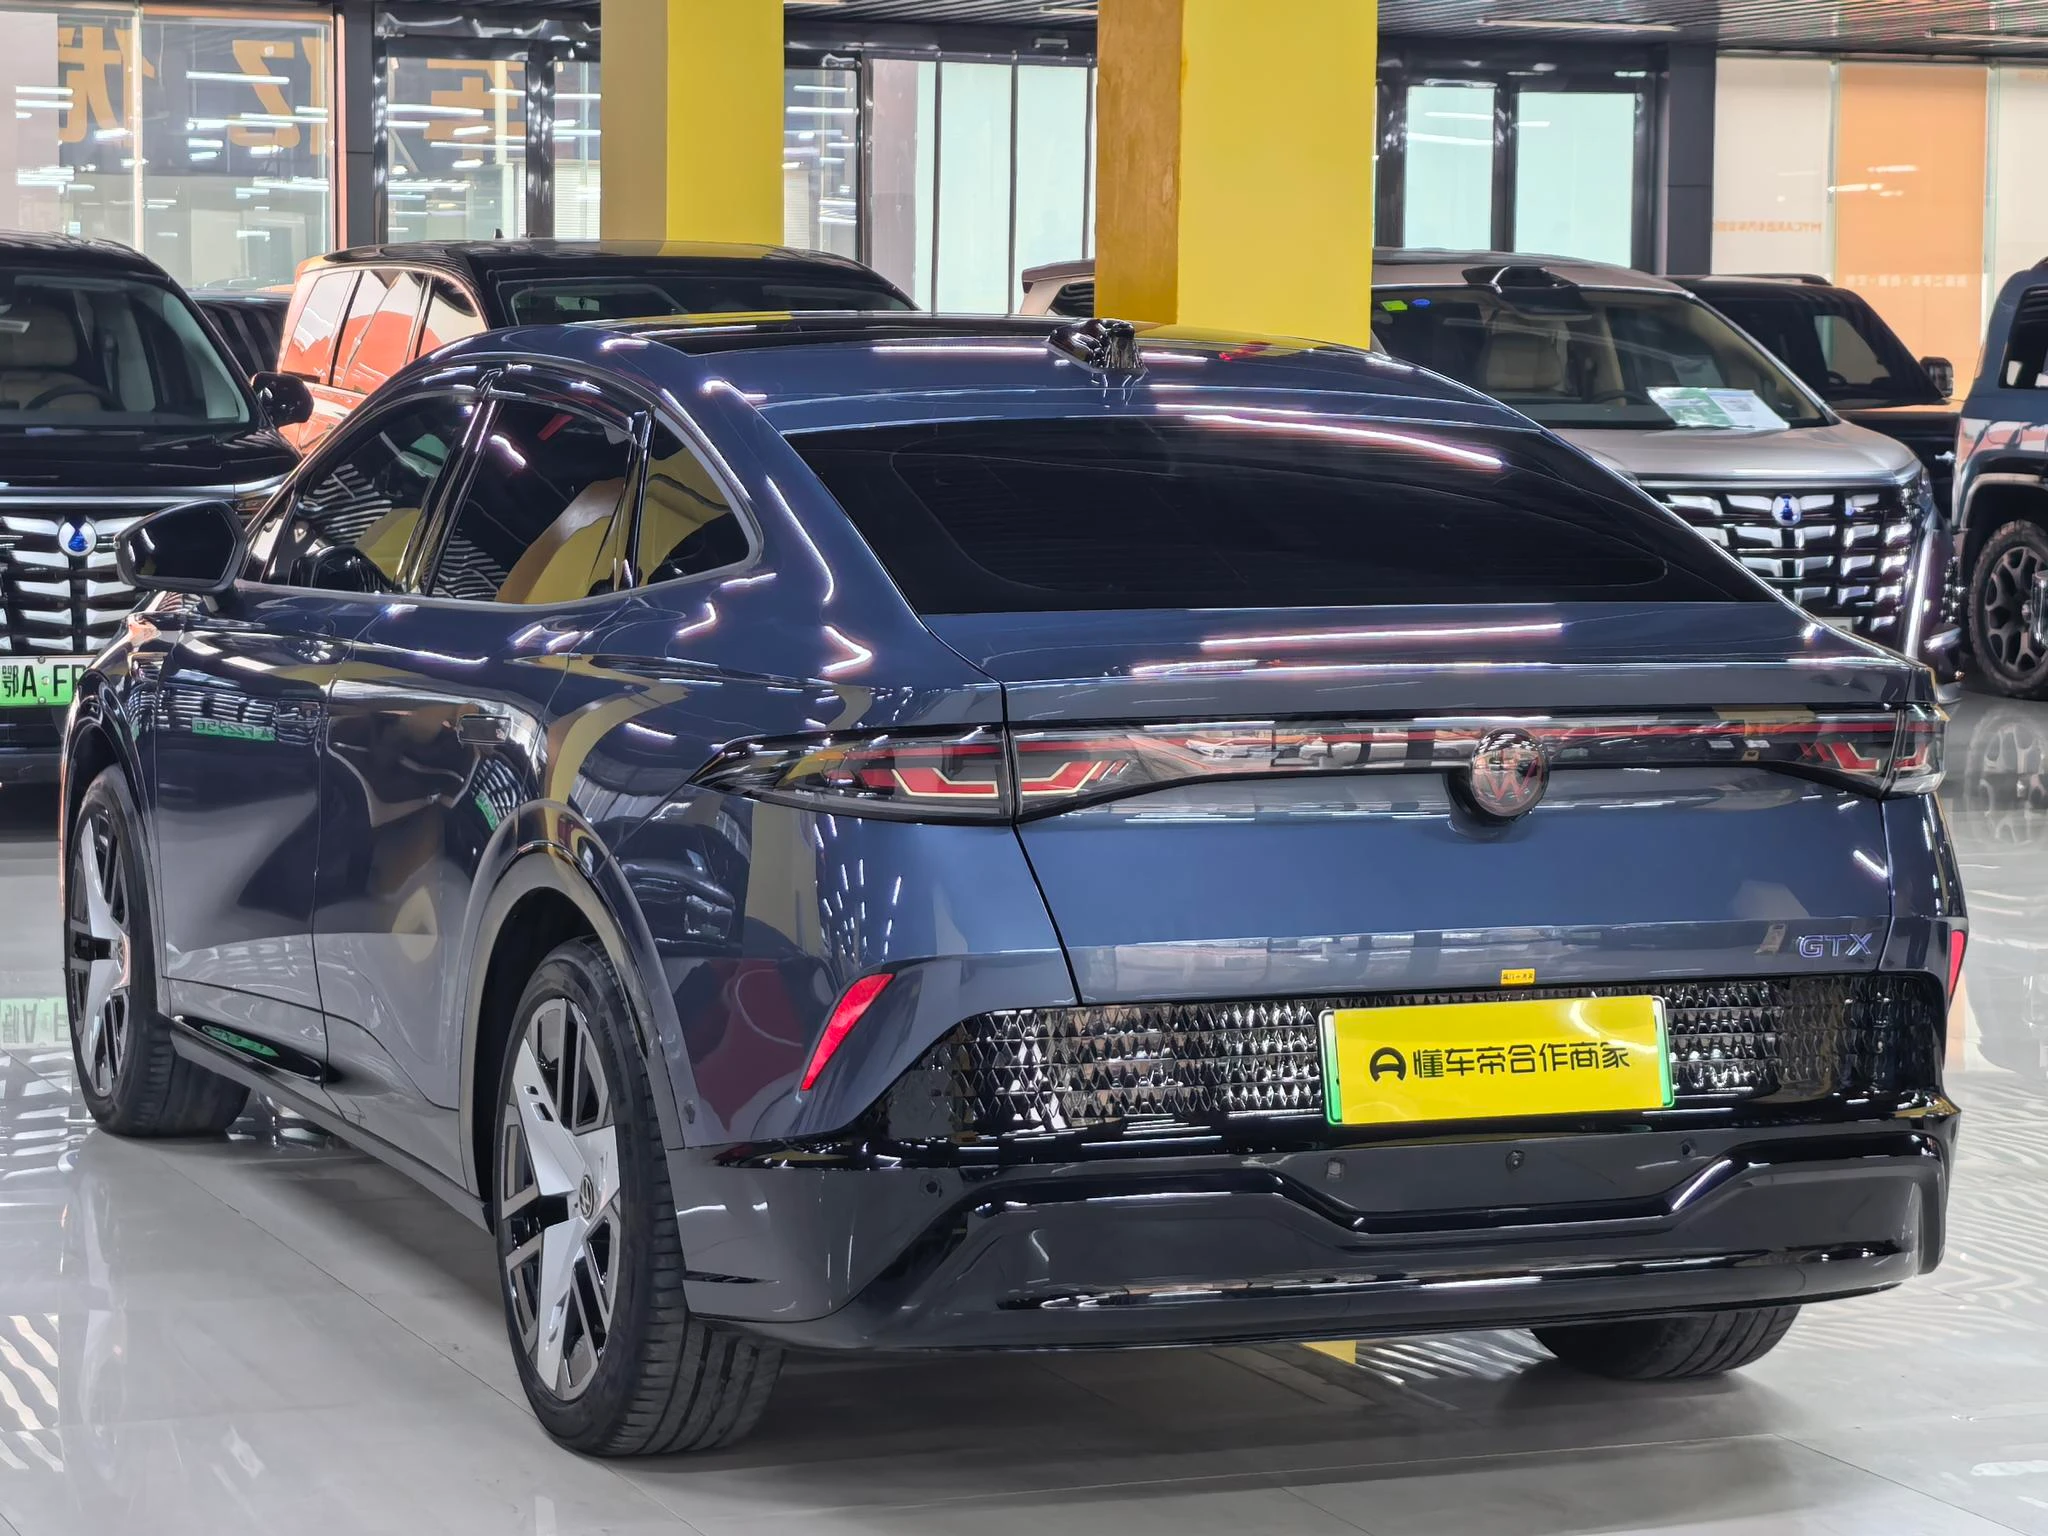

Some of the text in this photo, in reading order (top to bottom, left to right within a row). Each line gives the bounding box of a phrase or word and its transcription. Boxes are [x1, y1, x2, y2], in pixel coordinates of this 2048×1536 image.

[1798, 932, 1873, 958] GTX
[1413, 1042, 1631, 1078] 懂车帝合作商家
